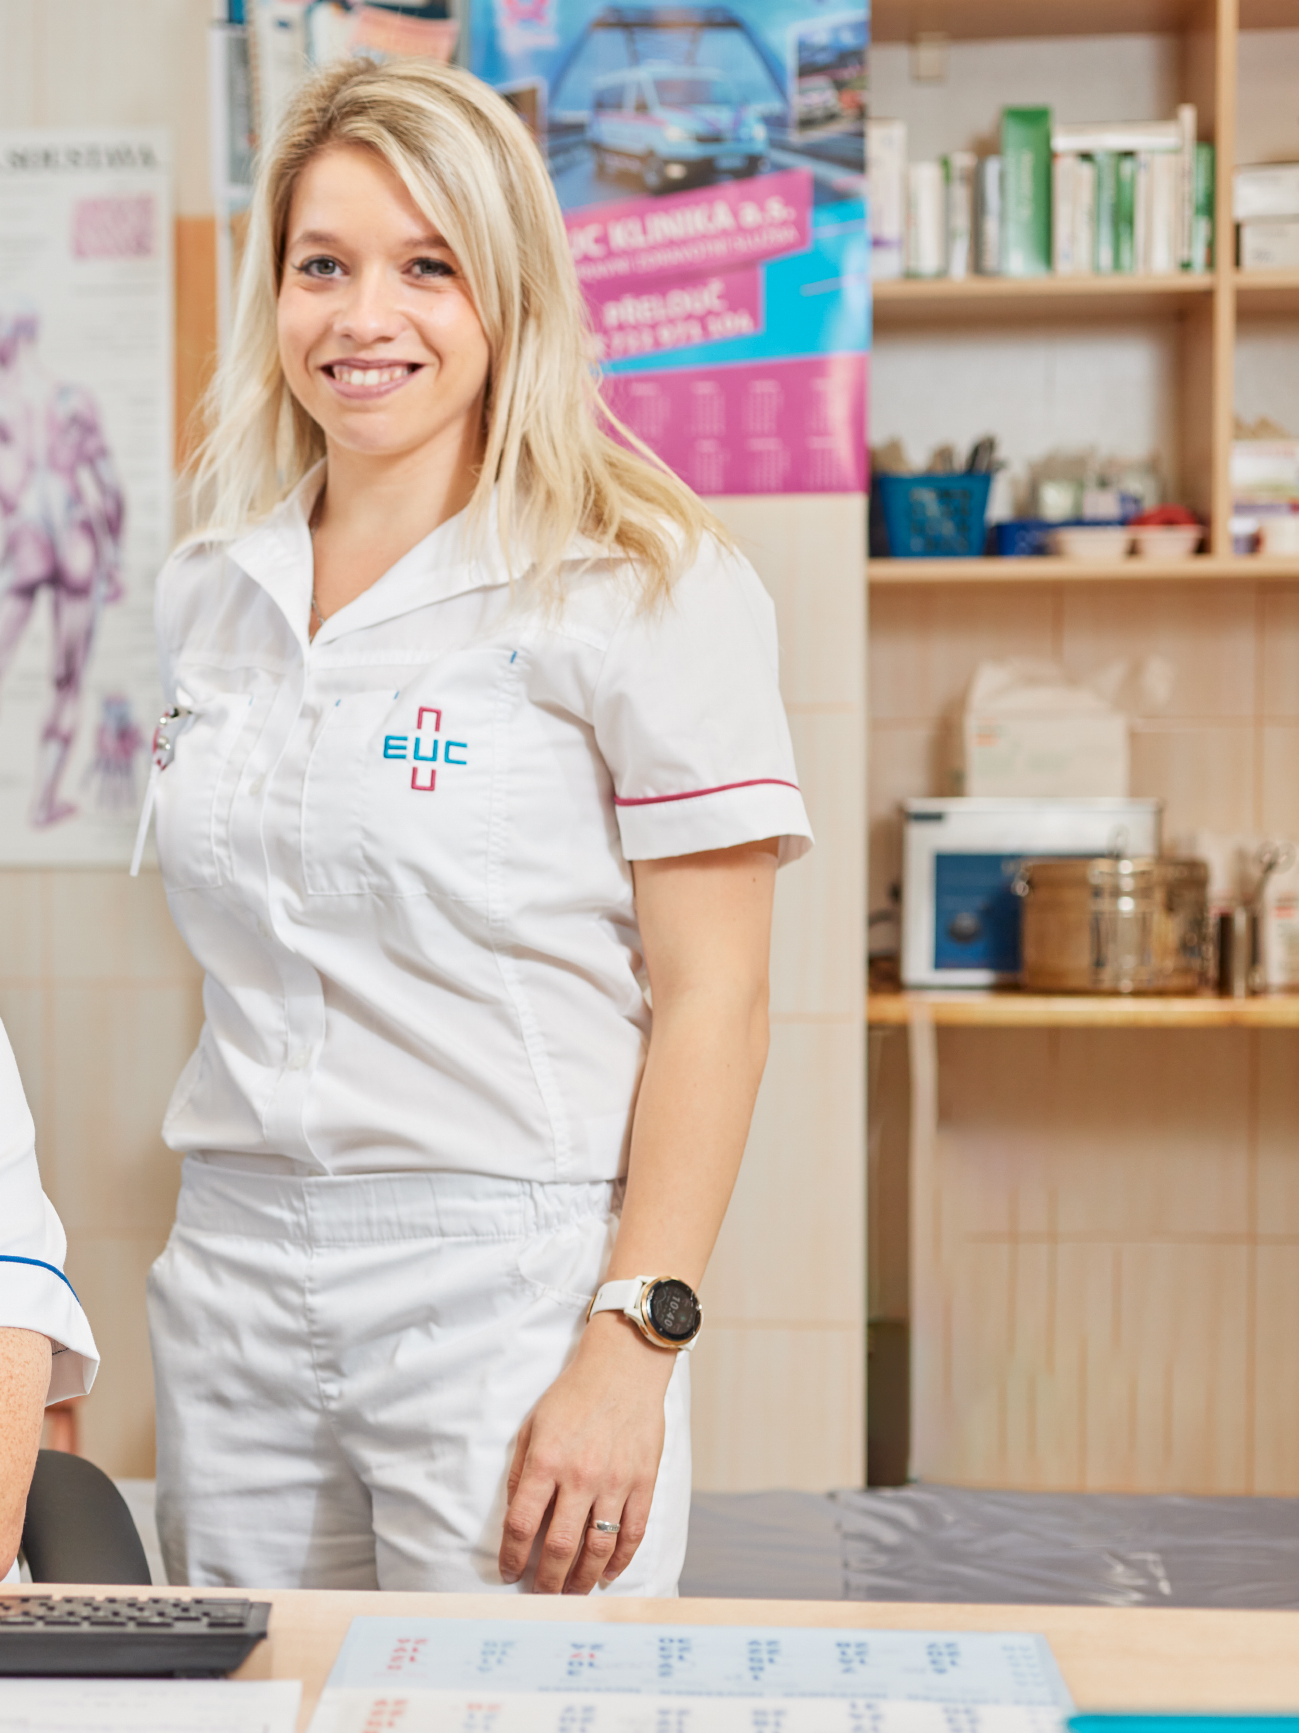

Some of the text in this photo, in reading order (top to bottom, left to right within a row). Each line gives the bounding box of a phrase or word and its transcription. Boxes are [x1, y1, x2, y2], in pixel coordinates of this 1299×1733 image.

[609, 201, 734, 250] KLINIKA
[737, 195, 796, 227] a.s.
[603, 280, 727, 329] PŘELOUČ
[383, 734, 468, 766] EUC
[663, 1295, 682, 1328] 10:40
